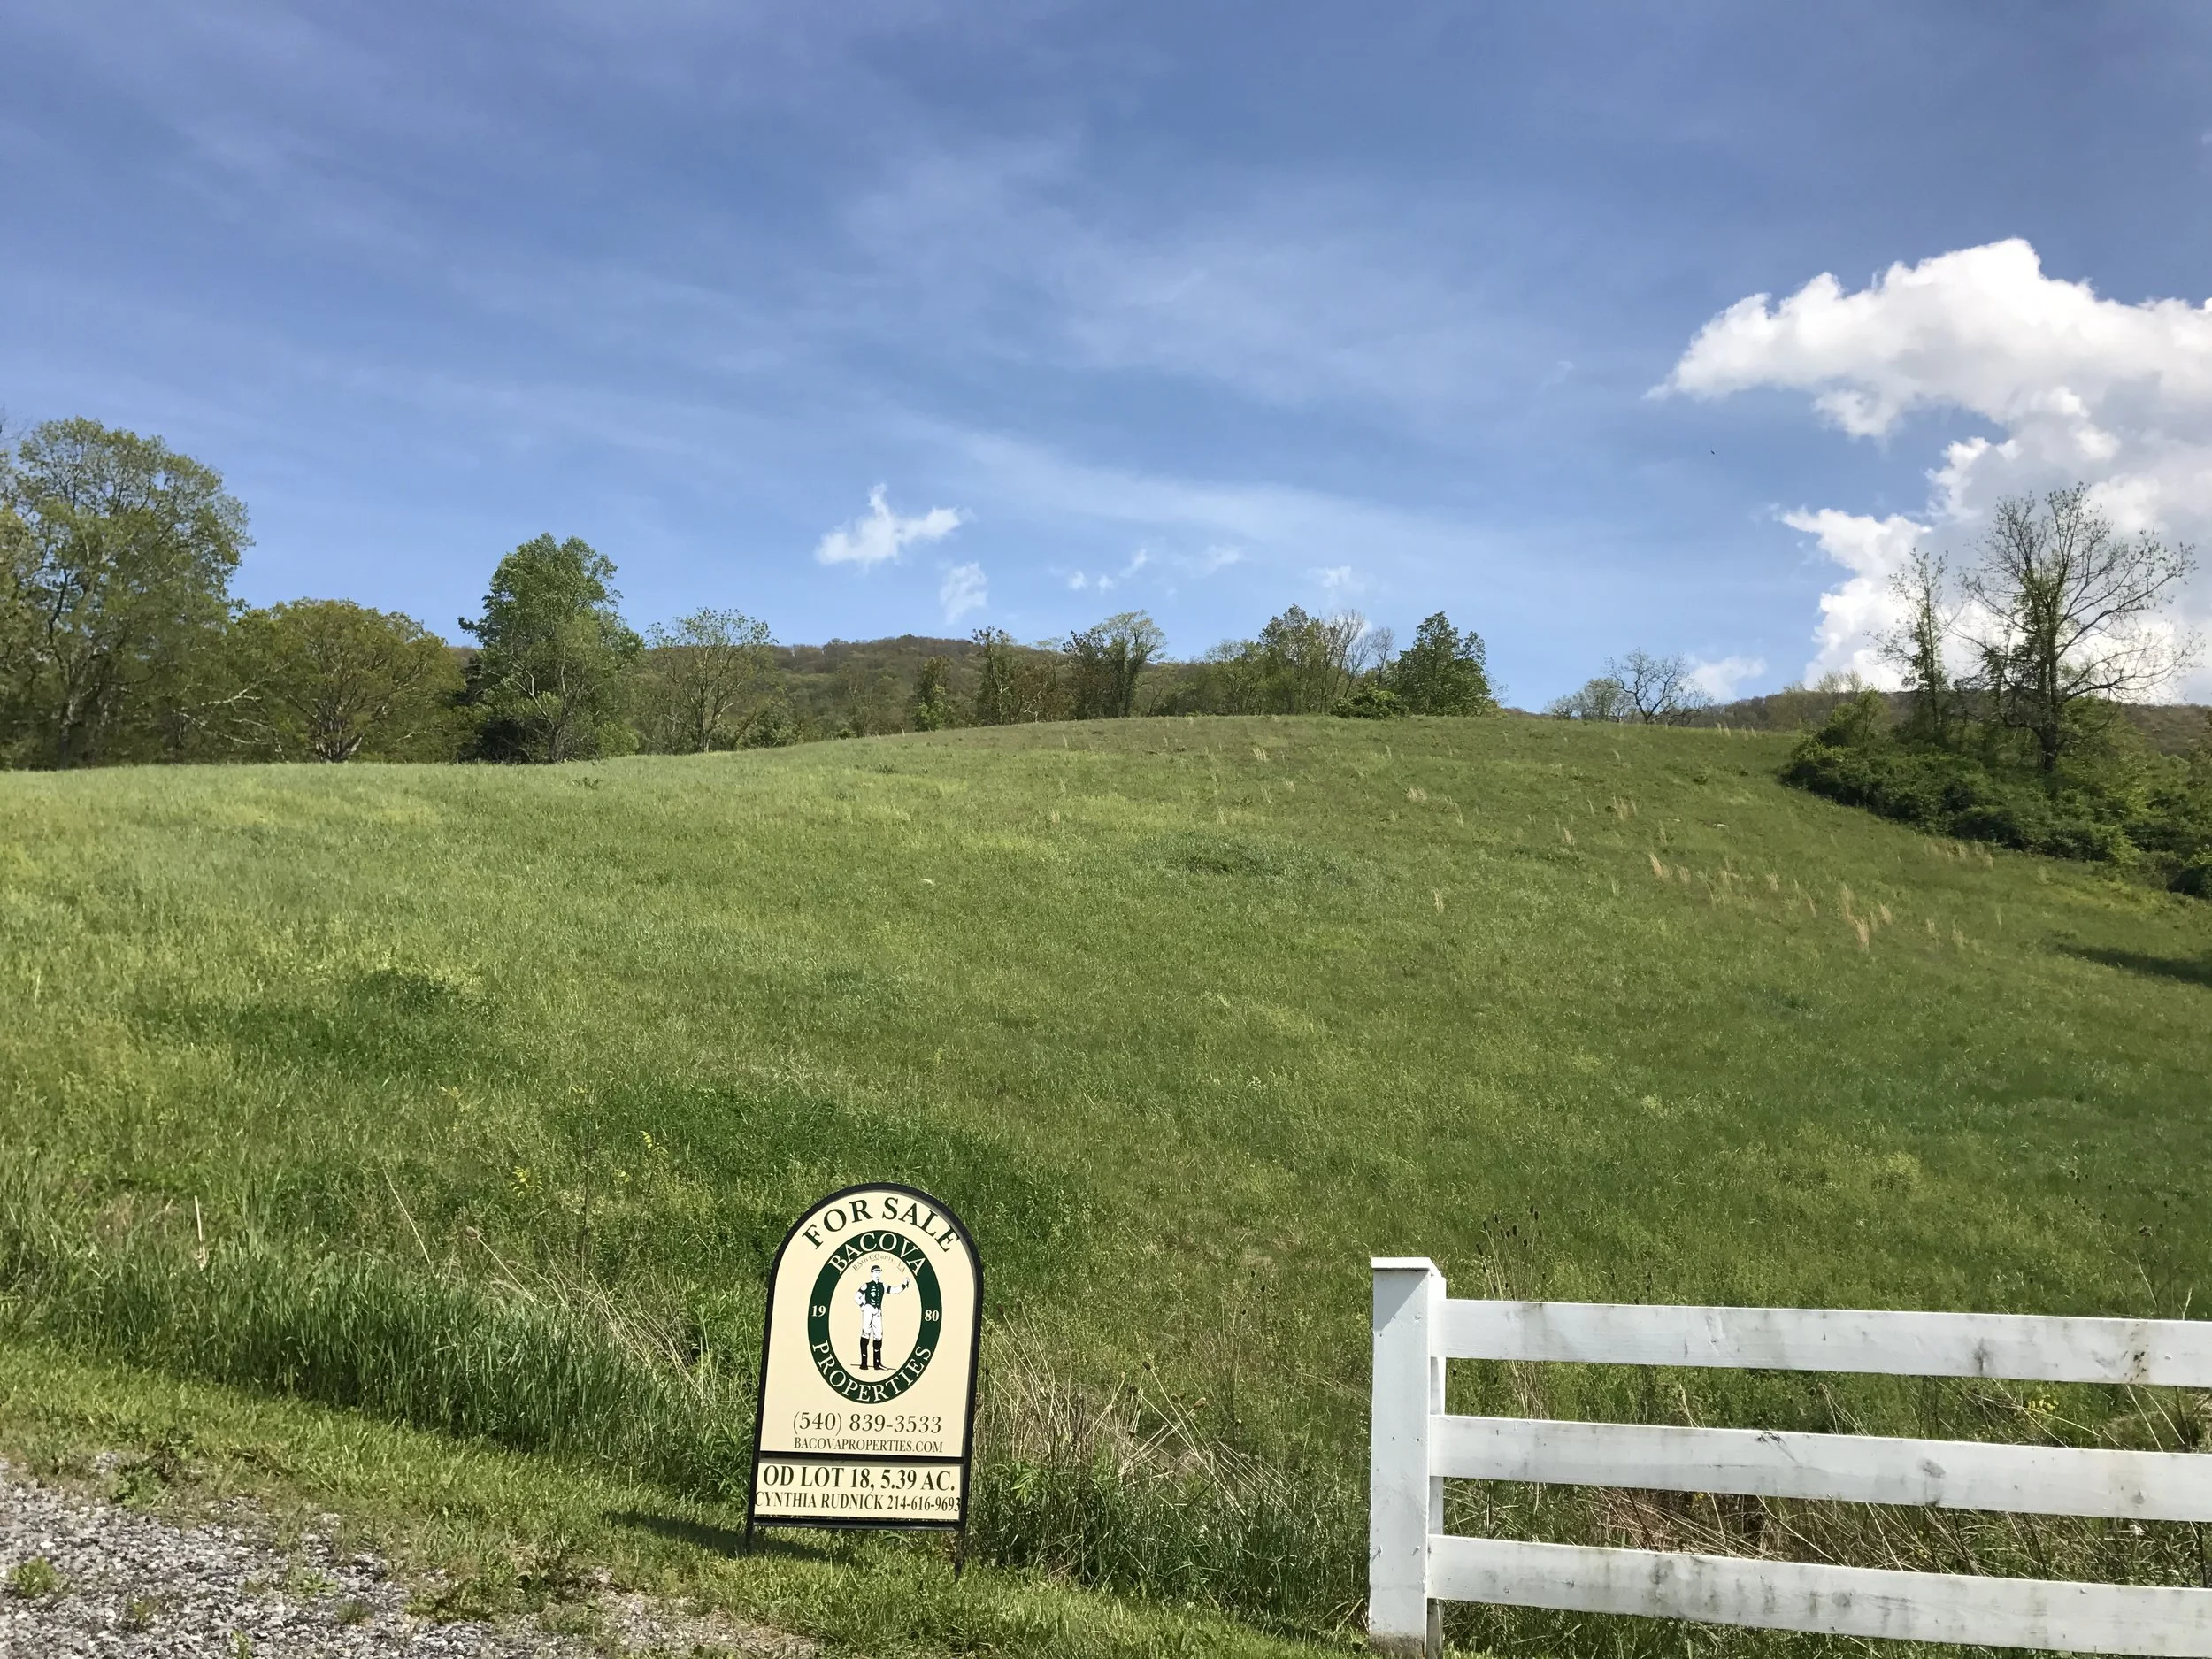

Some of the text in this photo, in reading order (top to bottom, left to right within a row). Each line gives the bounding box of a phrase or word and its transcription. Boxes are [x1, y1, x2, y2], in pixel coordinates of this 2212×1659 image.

[802, 1197, 960, 1253] FOR SALE
[827, 1232, 926, 1276] BACOVA
[811, 1304, 940, 1322] 19 80
[812, 1340, 931, 1402] PROPERTIES
[793, 1410, 941, 1436] (540) 839-3533
[794, 1437, 943, 1453] BACOVAPROPERTIES.COM
[763, 1464, 956, 1492] OD LOT 18, 5.39 AC.
[755, 1491, 961, 1512] CYNTHIA RUDNICK 214-616-9693
